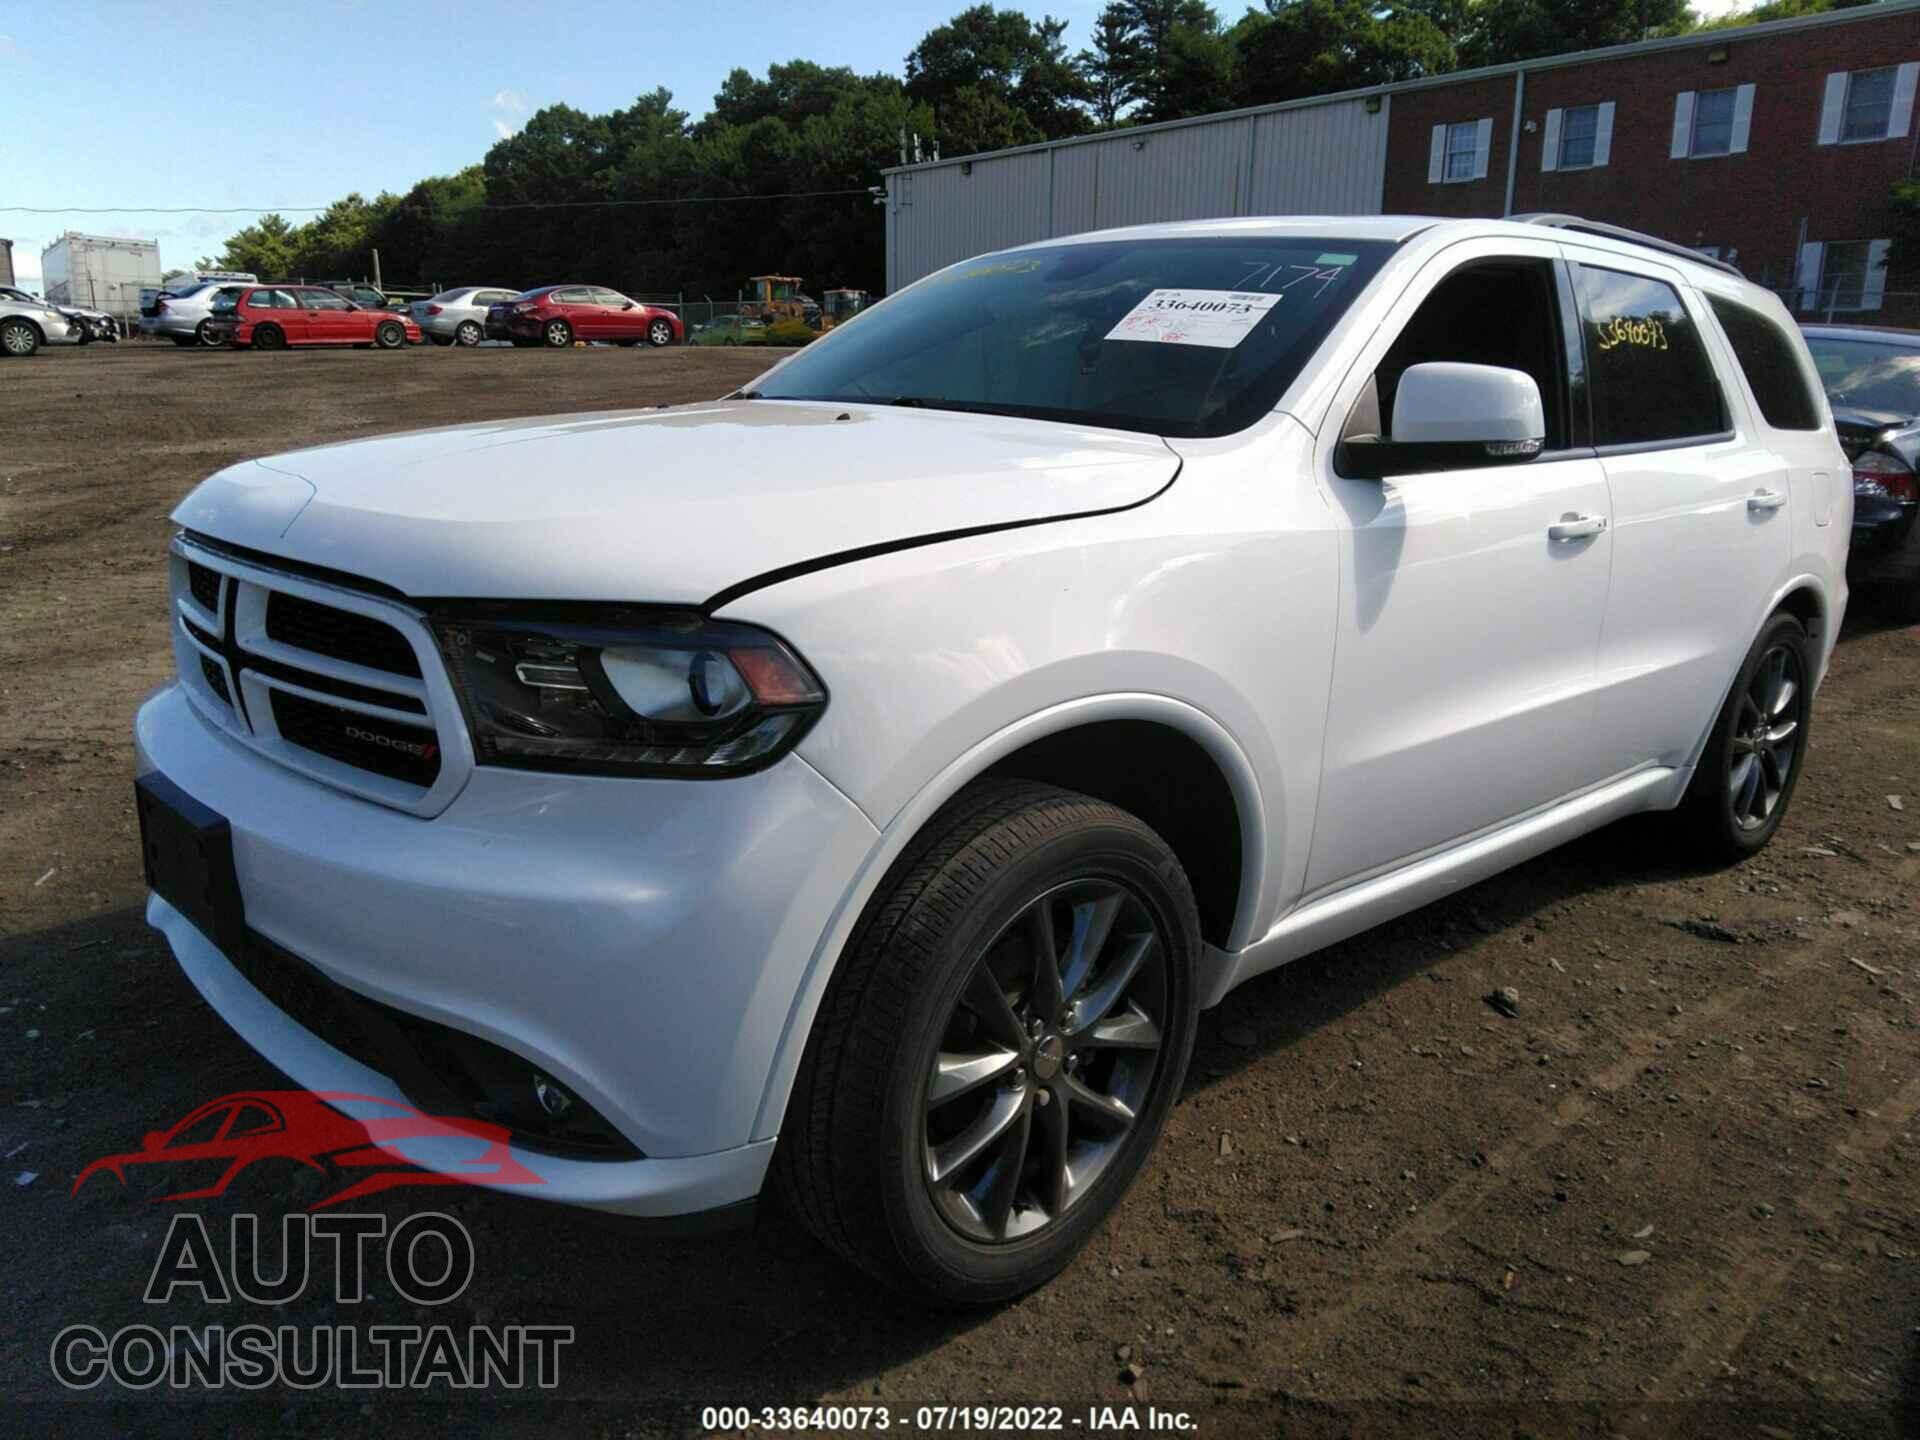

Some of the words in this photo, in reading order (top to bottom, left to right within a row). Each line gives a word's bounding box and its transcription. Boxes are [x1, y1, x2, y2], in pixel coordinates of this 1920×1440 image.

[1232, 261, 1343, 299] 7174
[1149, 299, 1252, 315] 33640073
[345, 726, 423, 756] DODGE
